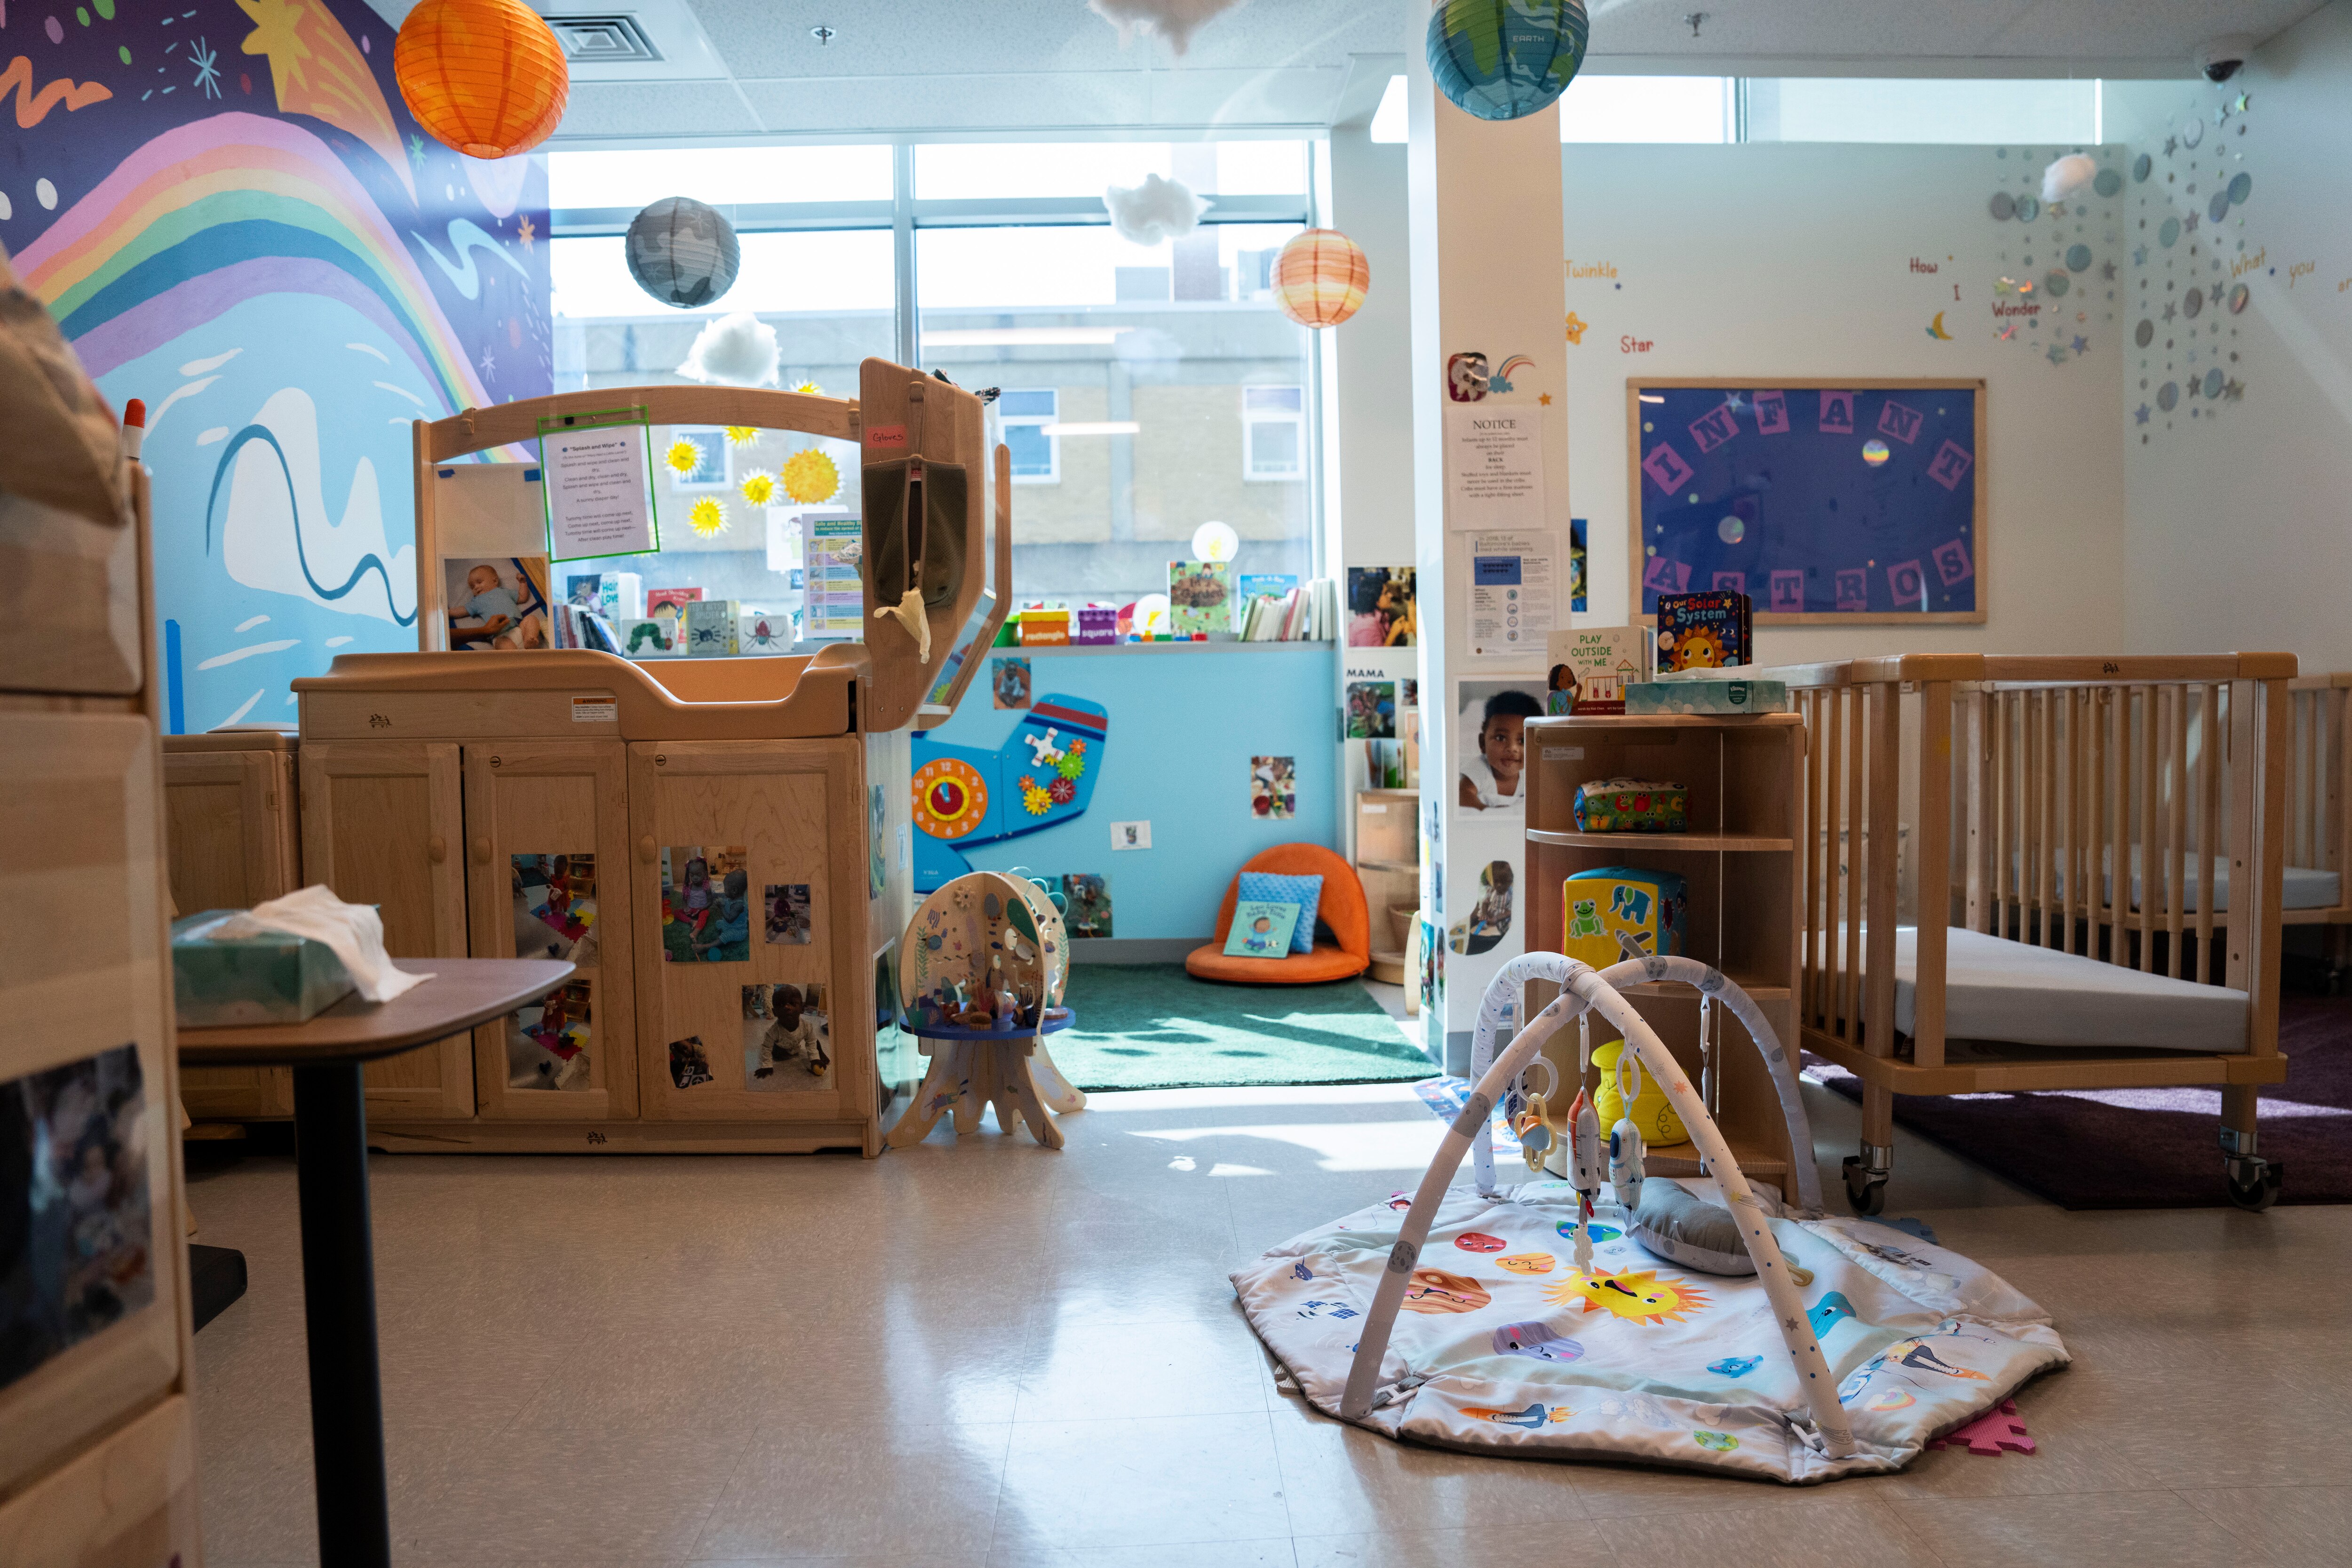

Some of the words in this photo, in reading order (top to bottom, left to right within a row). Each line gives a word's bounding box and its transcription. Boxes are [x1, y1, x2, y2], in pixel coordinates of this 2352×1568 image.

[1565, 260, 1618, 279] Twinkle
[1909, 257, 1938, 274] How
[2230, 246, 2265, 278] What
[2289, 260, 2315, 289] you
[1954, 283, 1961, 301] I
[1991, 301, 2041, 317] Wonder
[1621, 334, 1653, 353] Star
[1473, 419, 1516, 429] NOTICE
[873, 433, 903, 443] Gloves
[602, 580, 618, 593] Hair
[1673, 600, 1687, 609] Our
[1687, 597, 1722, 610] Solar
[1677, 606, 1727, 625] System
[1025, 631, 1065, 641] rectangle
[1082, 629, 1114, 639] square
[1580, 635, 1602, 644] PLAY
[1571, 646, 1612, 657] OUTSIDE
[1594, 658, 1607, 667] ME
[1347, 669, 1384, 677] MAMA
[925, 767, 934, 777] 11
[941, 762, 952, 772] 12
[960, 765, 965, 775] 1
[914, 778, 924, 789] 10
[971, 776, 979, 787] 2
[912, 795, 919, 805] 9
[976, 792, 984, 803] 3
[917, 812, 924, 821] 8
[971, 809, 979, 819] 4
[929, 822, 935, 832] 7
[946, 826, 953, 836] 6
[961, 821, 969, 831] 5
